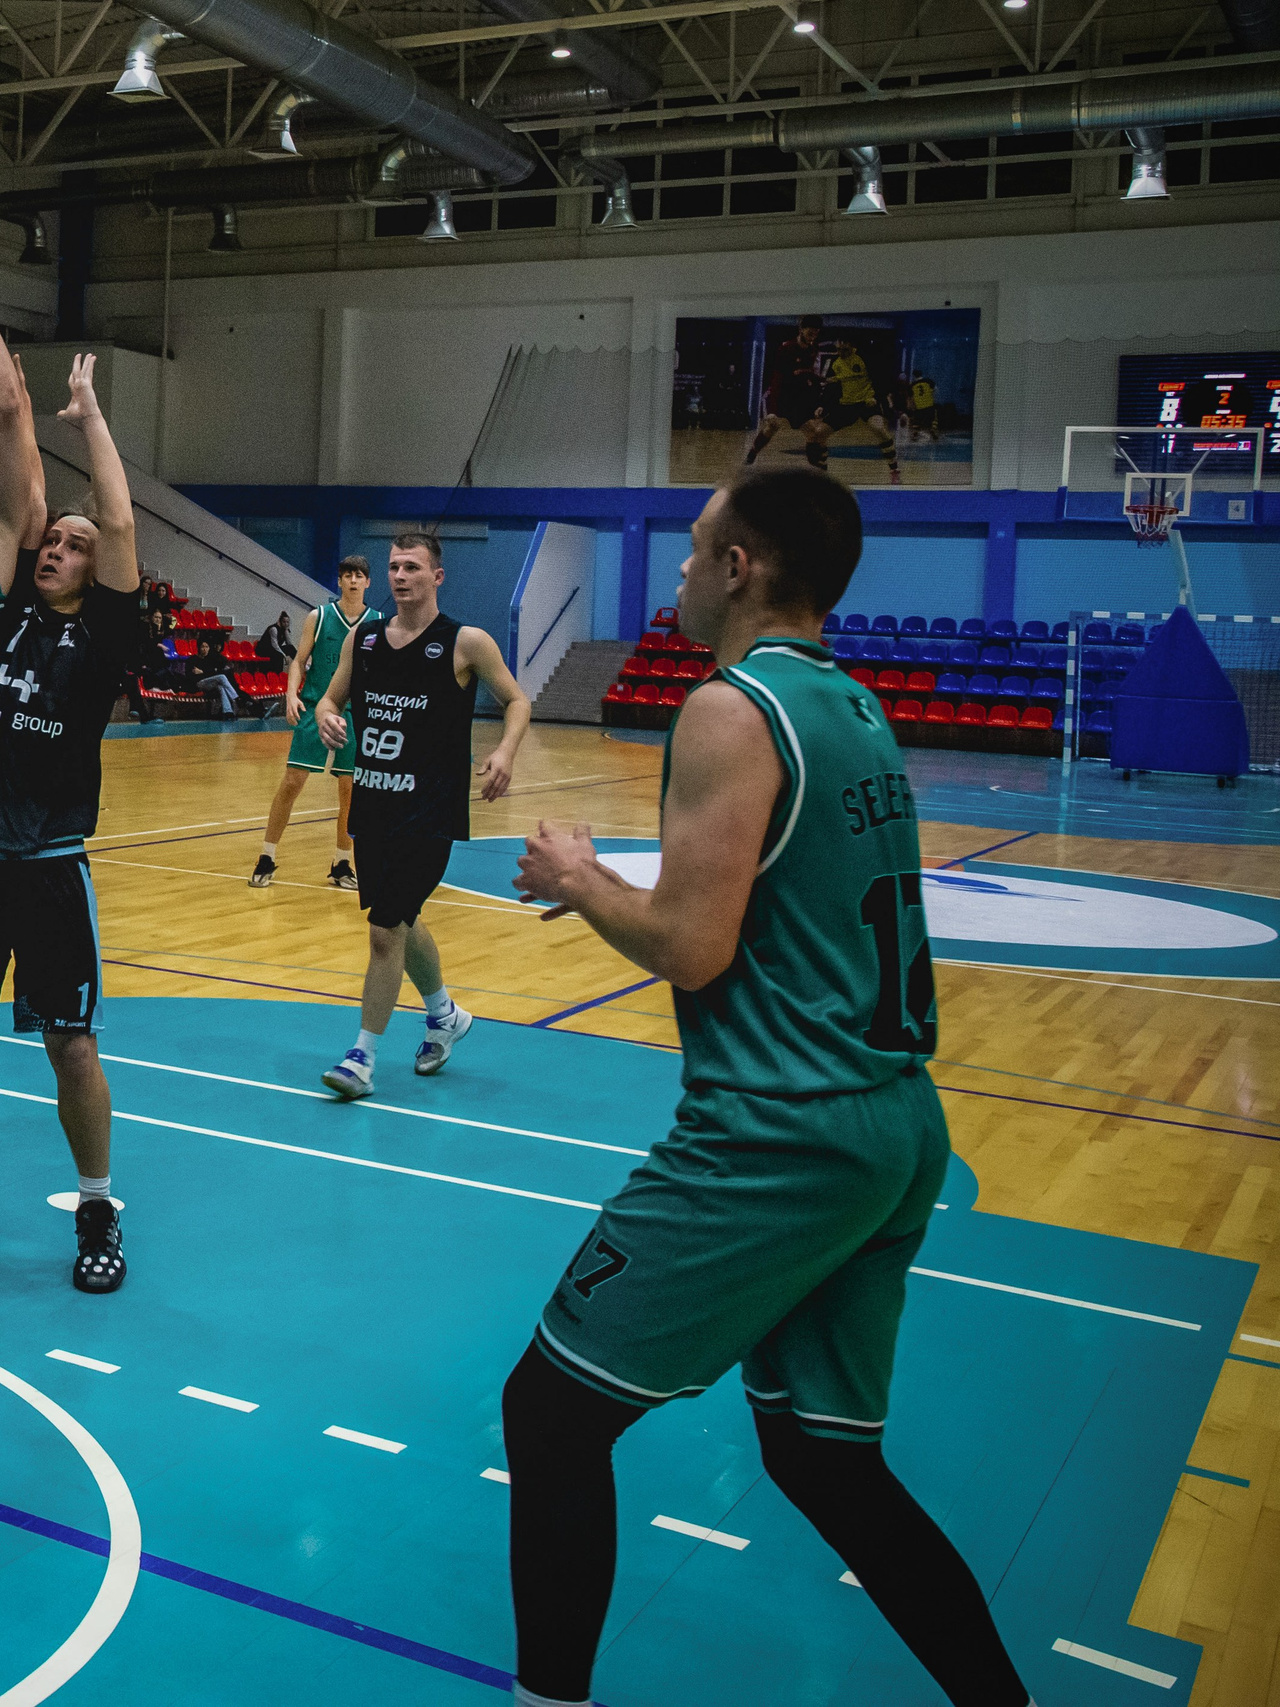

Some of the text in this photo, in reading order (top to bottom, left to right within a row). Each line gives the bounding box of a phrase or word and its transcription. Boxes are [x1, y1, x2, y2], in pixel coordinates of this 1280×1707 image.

[1159, 398, 1181, 422] 8
[1200, 414, 1247, 429] 05:35
[12, 712, 63, 739] group
[367, 707, 403, 723] КРАЙ
[353, 767, 415, 792] PARMA
[77, 981, 90, 1018] 1
